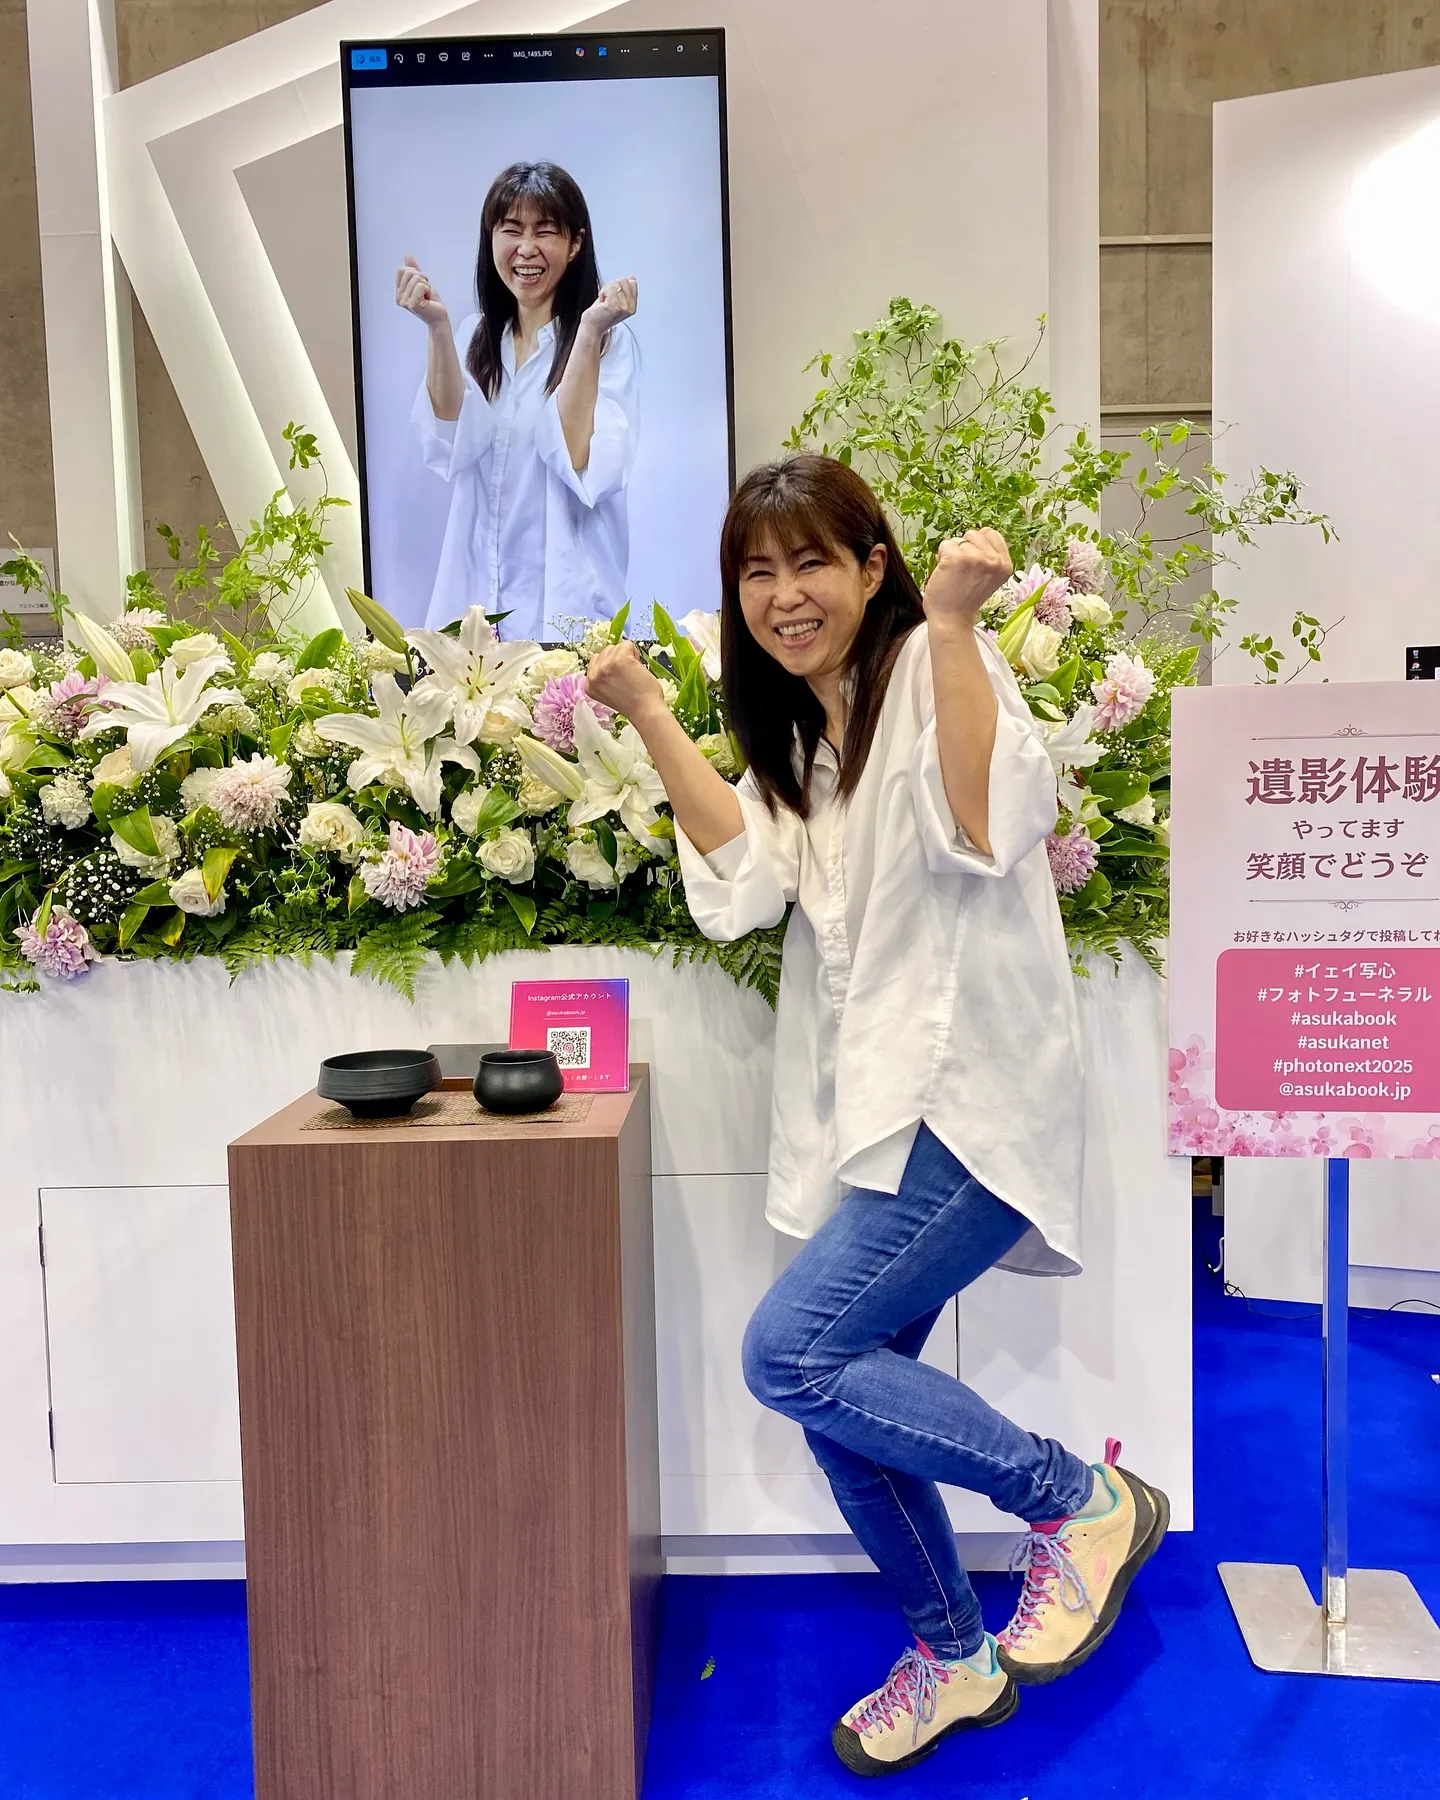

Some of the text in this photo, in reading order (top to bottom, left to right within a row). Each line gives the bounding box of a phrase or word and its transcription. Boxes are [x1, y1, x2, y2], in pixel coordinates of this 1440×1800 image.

[1245, 754, 1440, 806] 遺影体験
[1293, 818, 1405, 840] やってます
[1246, 851, 1429, 881] 笑顔でどうぞ
[527, 992, 612, 1003] Instagram公式アカウント
[1257, 986, 1433, 1003] #フォトフューネラル
[1290, 1011, 1398, 1027] #asukabook
[1297, 1035, 1390, 1050] #asukanet
[1272, 1058, 1414, 1077] #photonext2025
[1279, 1082, 1412, 1101] @asukabook.jp
